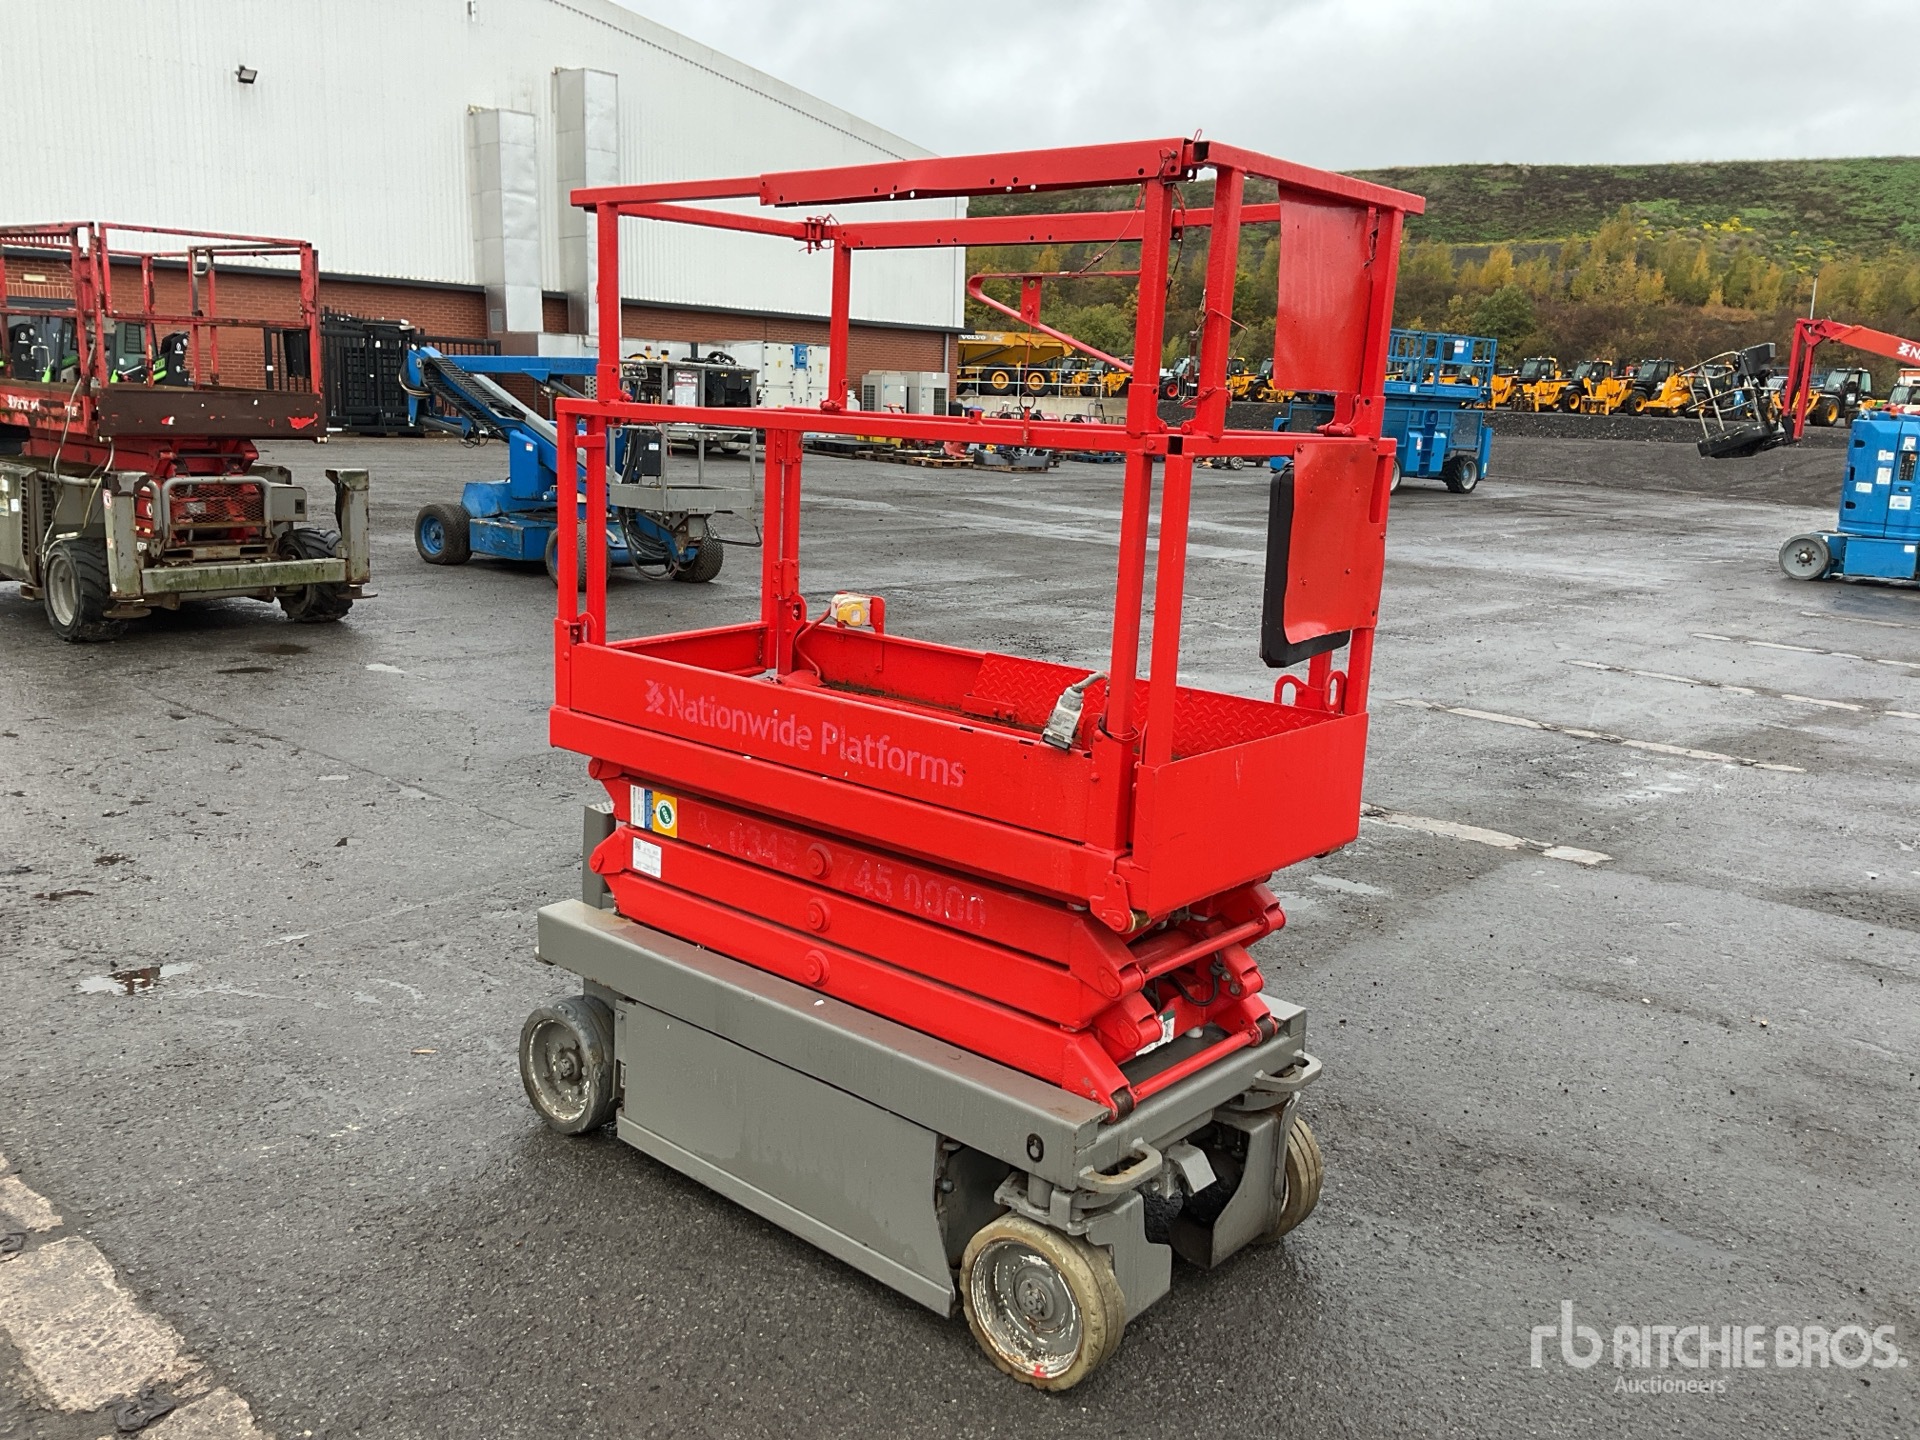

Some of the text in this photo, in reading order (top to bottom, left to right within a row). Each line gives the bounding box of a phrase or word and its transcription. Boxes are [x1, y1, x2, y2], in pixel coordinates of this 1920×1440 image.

[668, 686, 966, 788] Nationwide Platforms
[835, 853, 893, 902] 745
